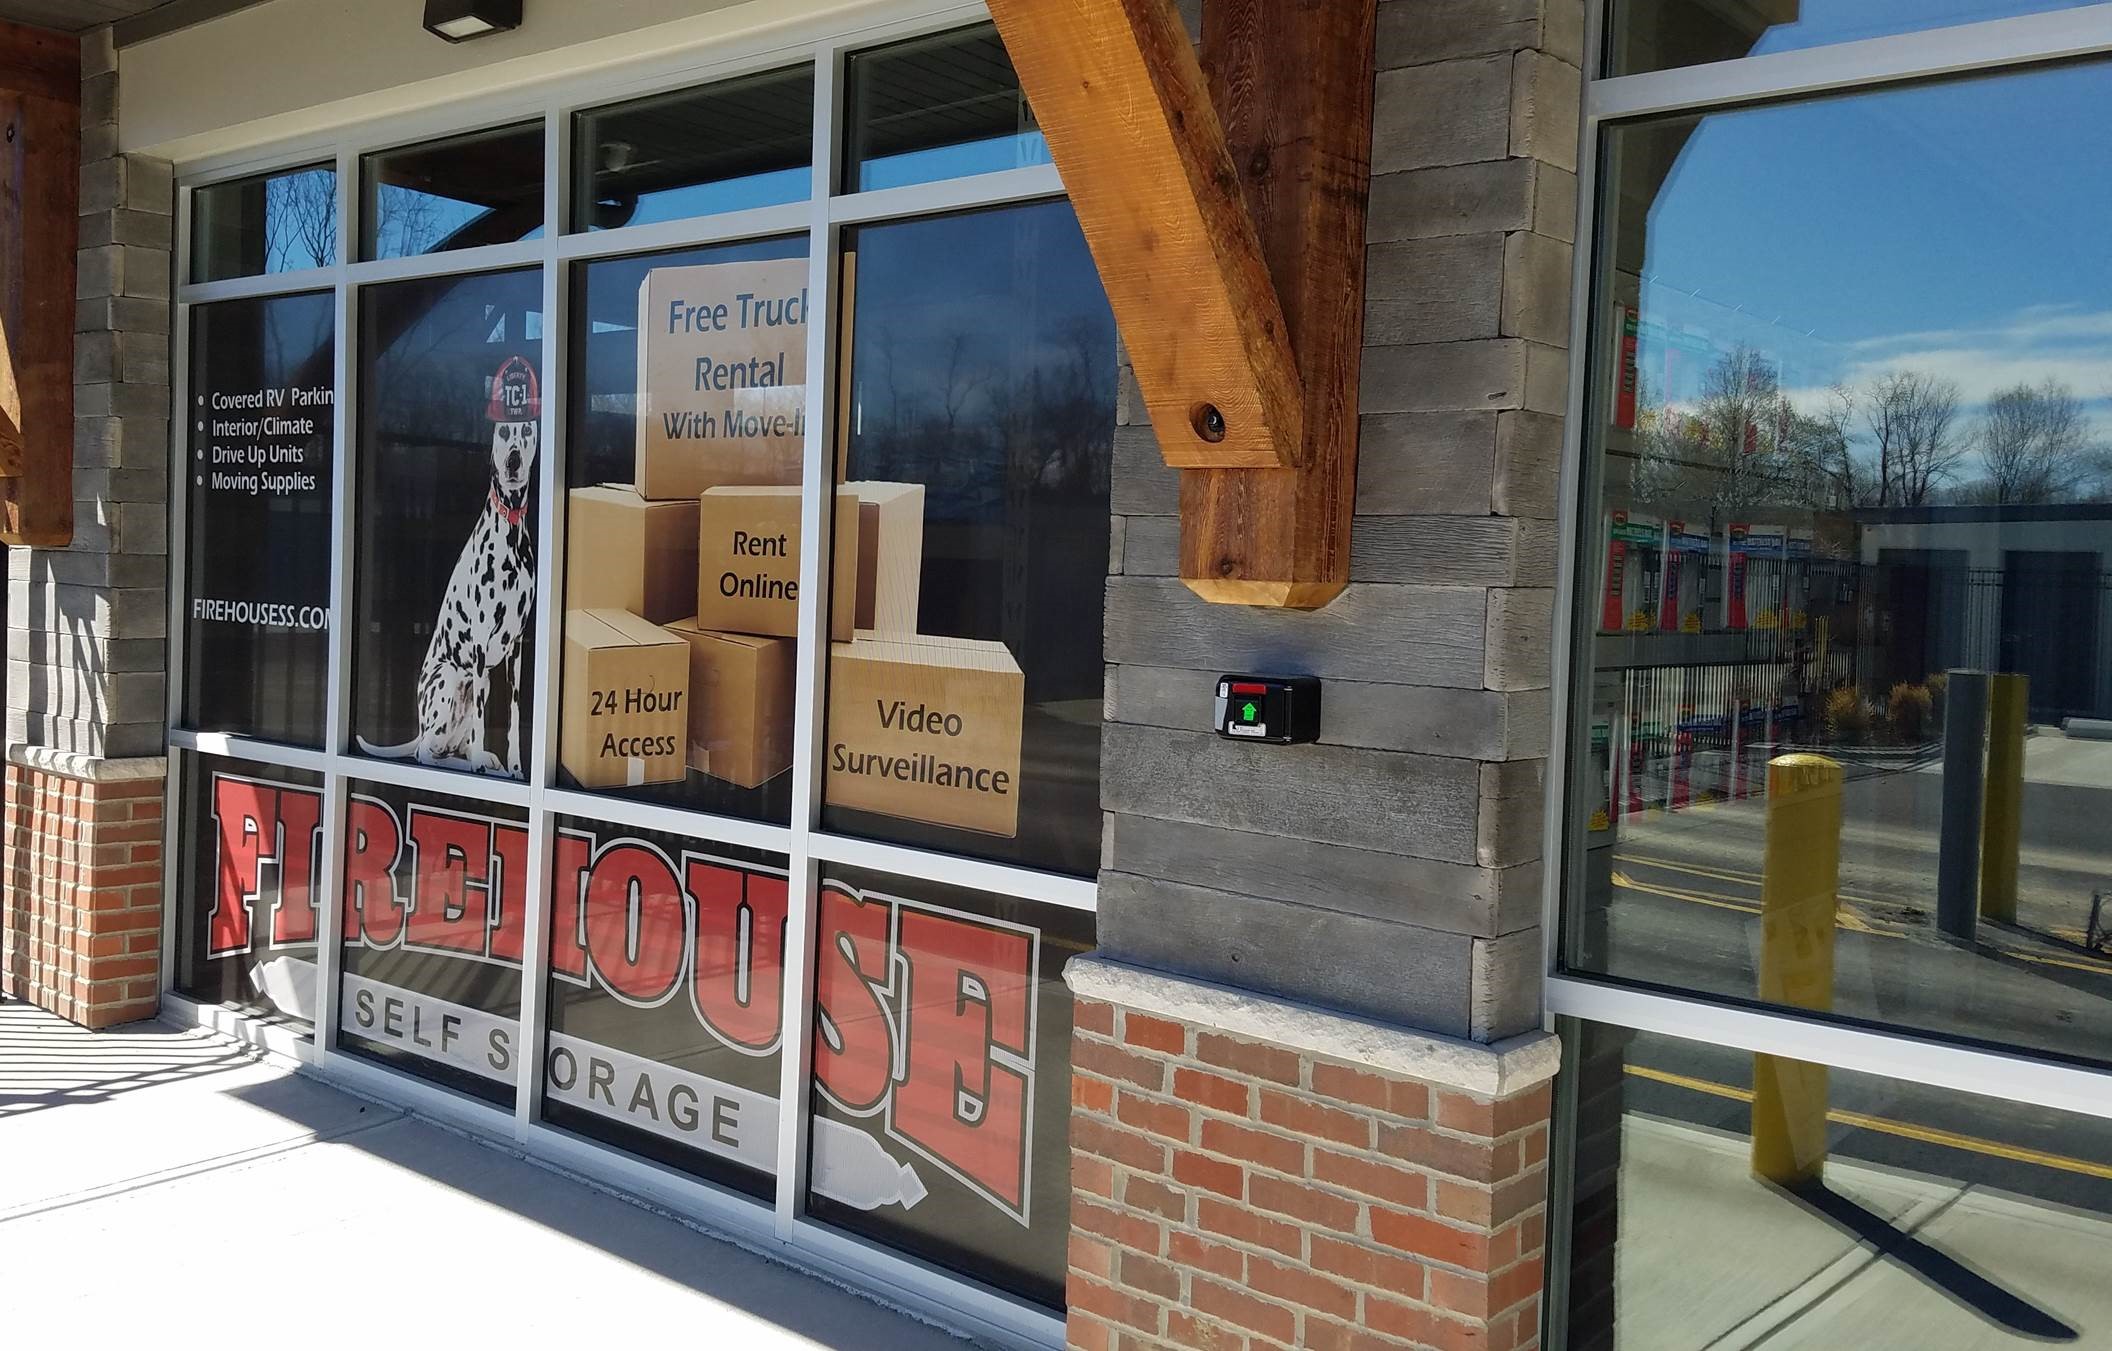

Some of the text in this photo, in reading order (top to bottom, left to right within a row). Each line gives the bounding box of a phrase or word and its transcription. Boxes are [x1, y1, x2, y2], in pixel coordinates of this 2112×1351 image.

[669, 300, 728, 334] Free
[695, 352, 785, 391] Rental
[212, 386, 334, 409] Covered RV Parkin
[212, 417, 313, 440] Interior/Climate
[663, 408, 805, 440] With Move-I
[212, 444, 304, 468] Drive Up Units
[211, 471, 316, 495] Moving Supplies
[733, 530, 787, 557] Rent
[720, 571, 799, 601] Online
[591, 687, 683, 716] 24 Hour
[877, 699, 963, 737] Video
[600, 733, 676, 758] Access
[832, 743, 1010, 795] Surveillance
[355, 988, 741, 1148] SELF SORAGE
